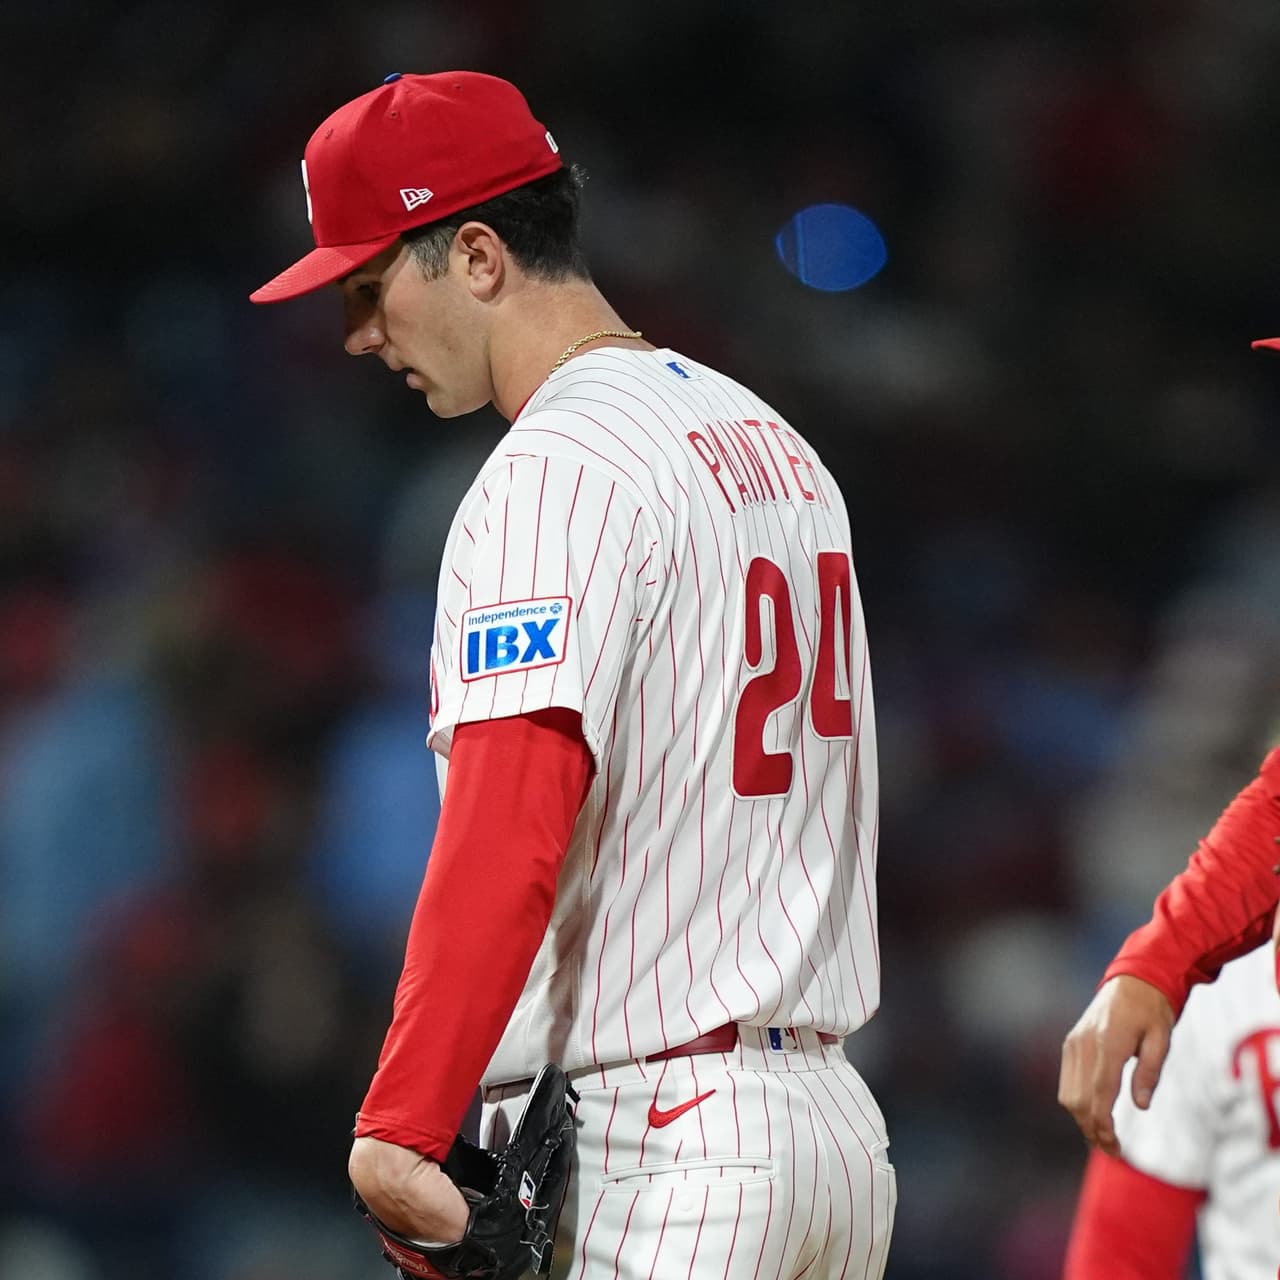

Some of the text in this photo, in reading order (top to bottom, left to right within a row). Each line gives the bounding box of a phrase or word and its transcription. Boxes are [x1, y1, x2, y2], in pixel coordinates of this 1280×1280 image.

[468, 605, 557, 626] Independence
[467, 618, 561, 675] IBX
[732, 553, 853, 798] 24
